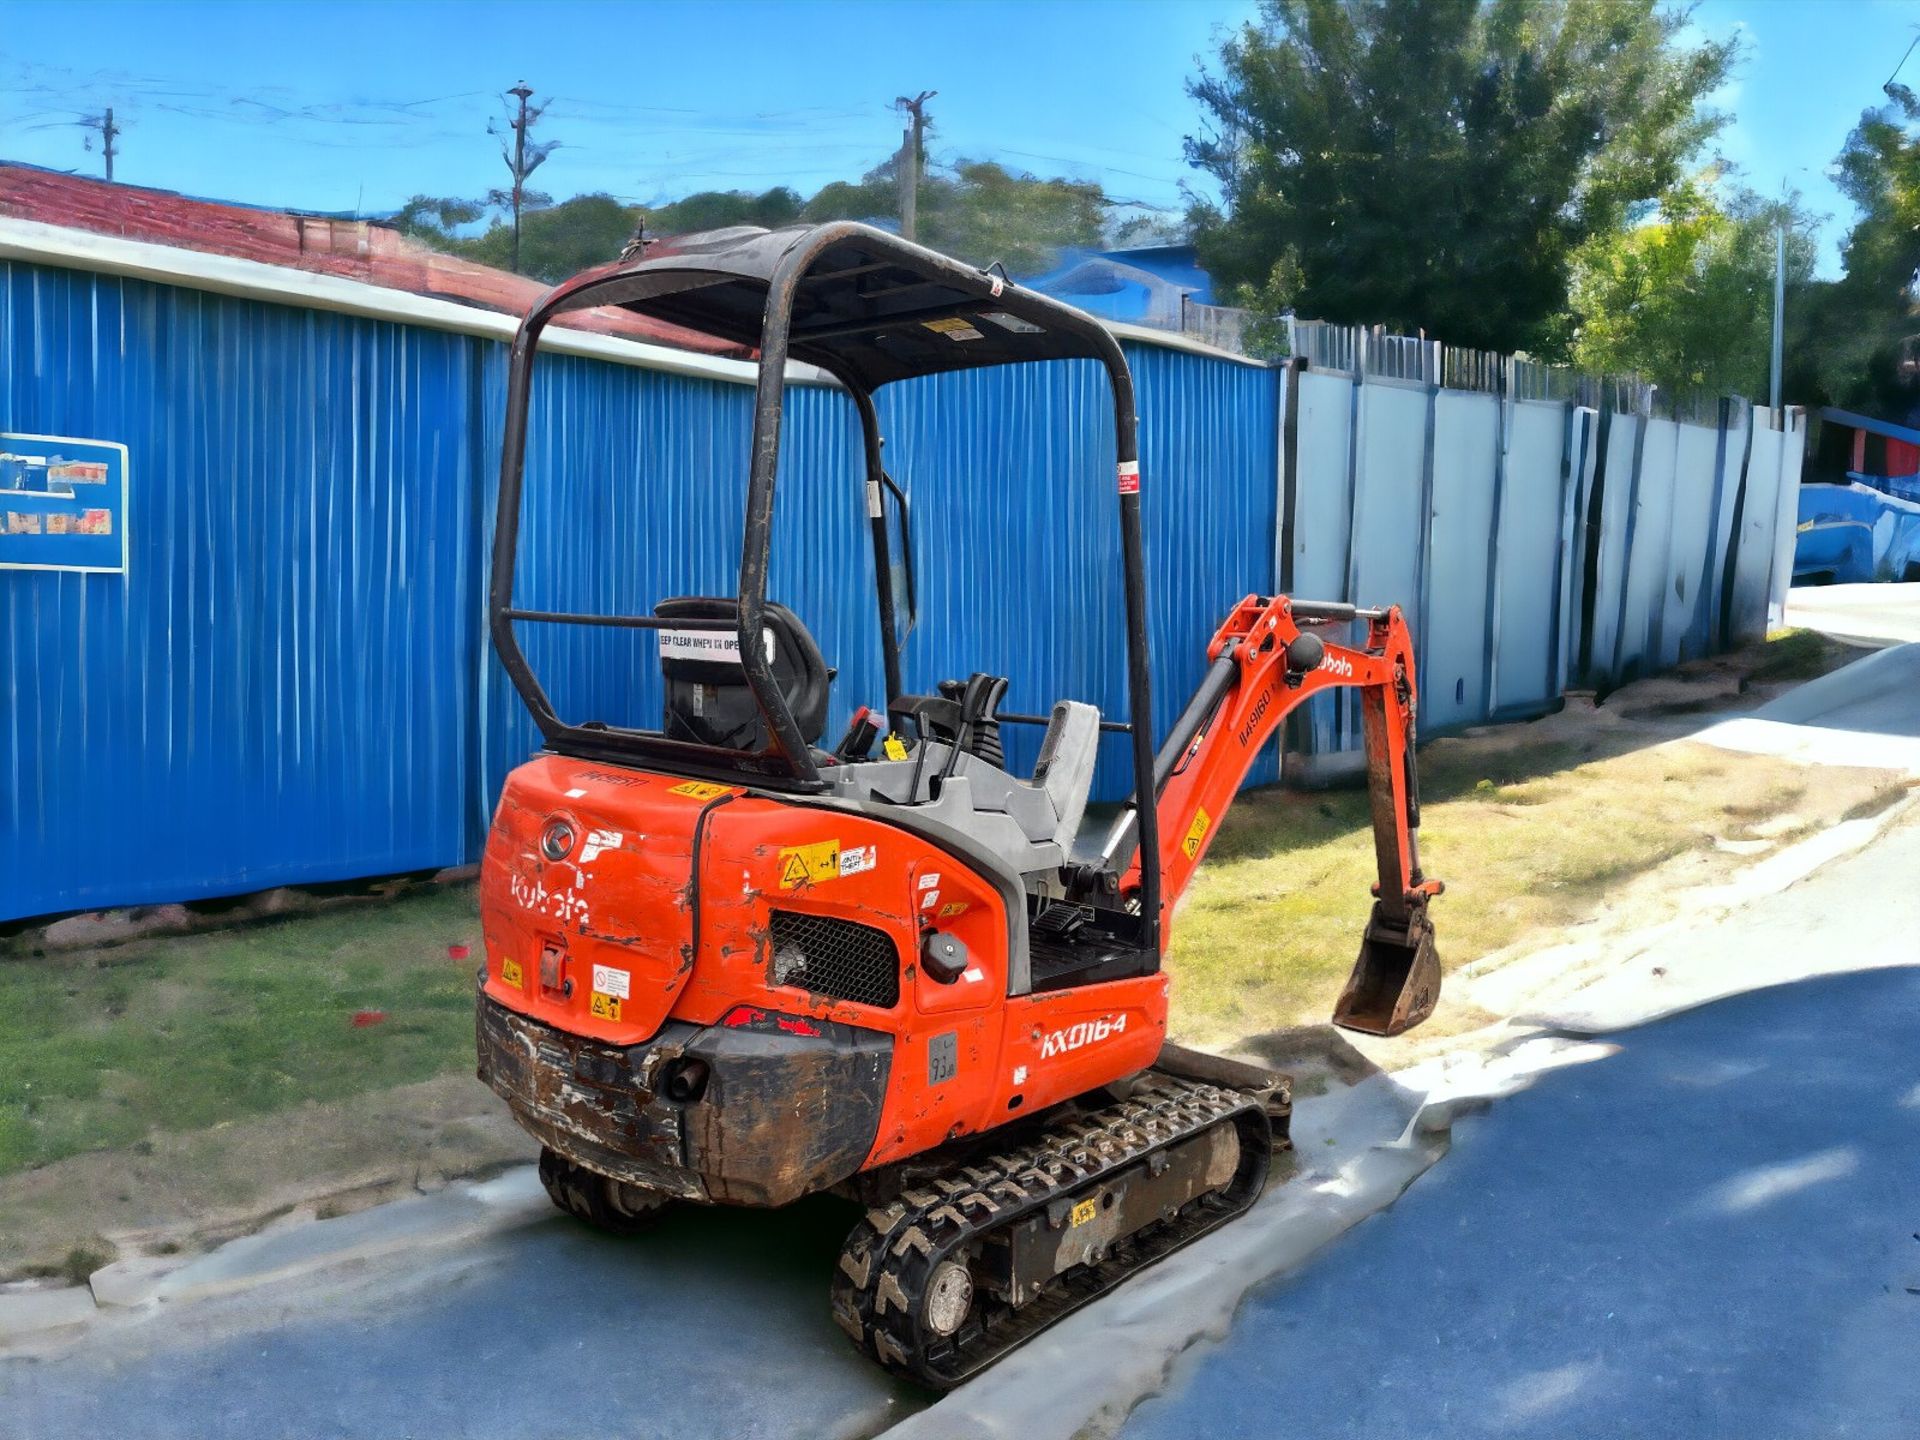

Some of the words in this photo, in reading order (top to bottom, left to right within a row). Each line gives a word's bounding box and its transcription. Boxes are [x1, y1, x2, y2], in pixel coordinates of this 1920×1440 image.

[661, 635, 671, 645] EEP
[673, 636, 692, 647] CLEAR
[1318, 652, 1352, 677] ubota
[1040, 1013, 1127, 1060] KX016-4
